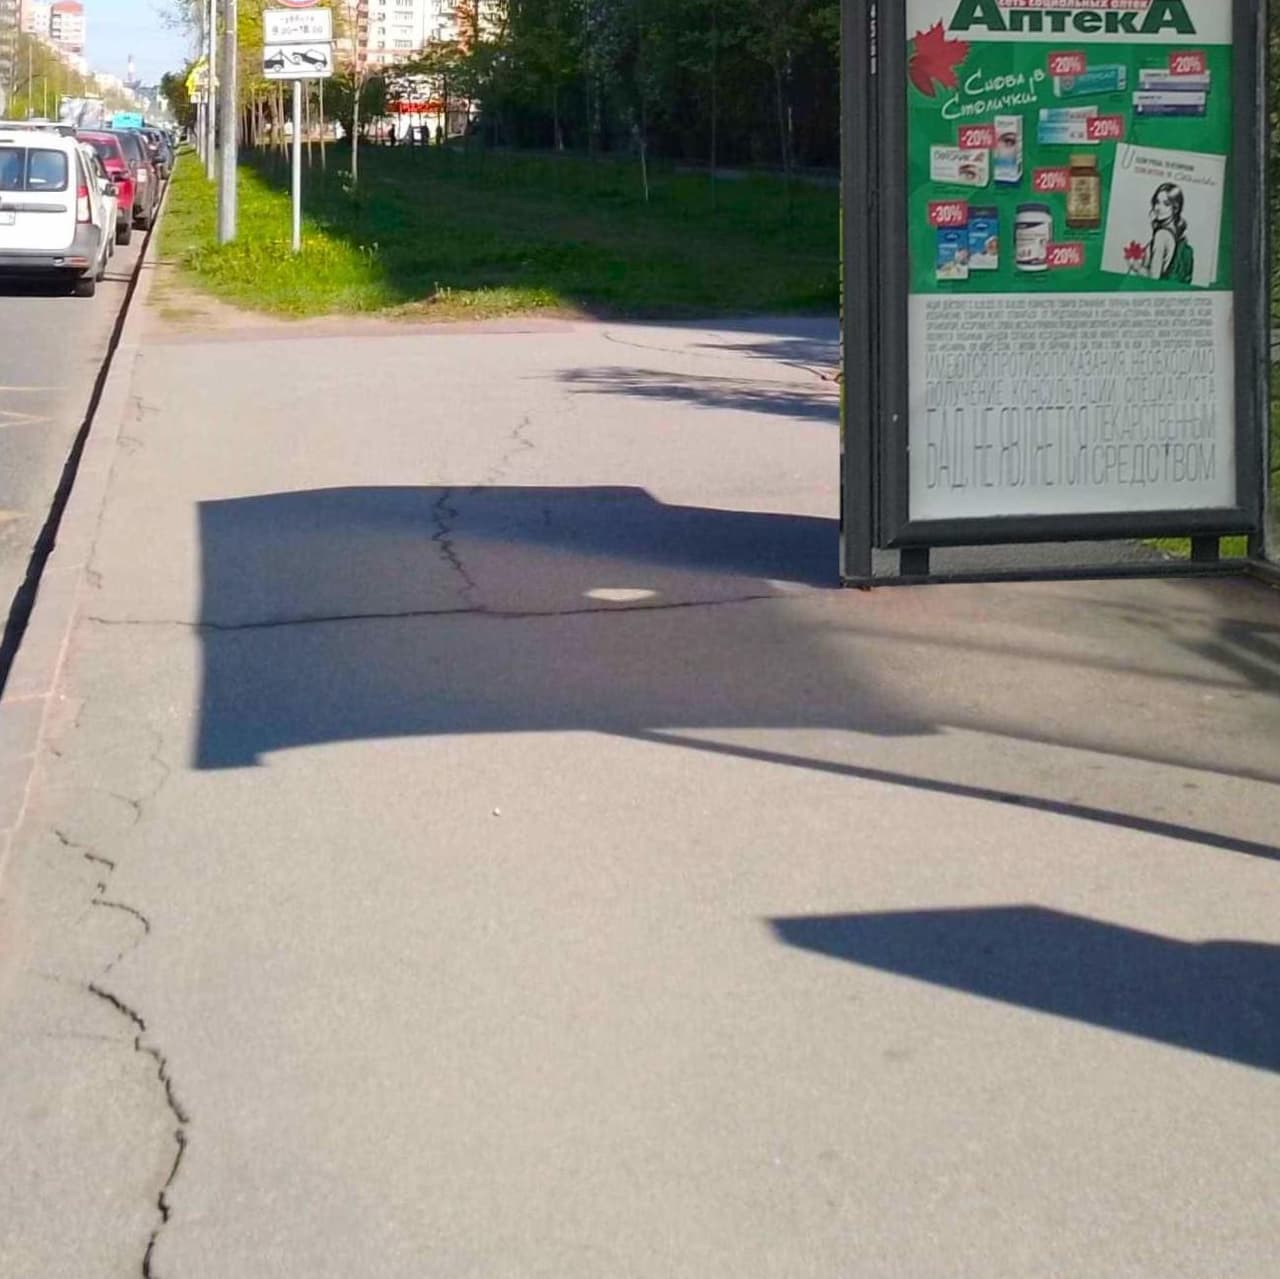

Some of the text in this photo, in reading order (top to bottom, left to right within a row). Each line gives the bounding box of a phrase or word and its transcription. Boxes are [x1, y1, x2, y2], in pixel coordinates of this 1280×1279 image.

[1051, 55, 1082, 73] -20%
[1172, 55, 1202, 73] -20%
[964, 68, 1025, 95] Снова
[1089, 118, 1121, 137] -20%
[960, 129, 993, 147] -20%
[1035, 170, 1067, 189] -20%
[931, 204, 963, 224] -30%
[1048, 246, 1080, 265] -20%
[1092, 443, 1216, 487] СРЕДСТВОМ
